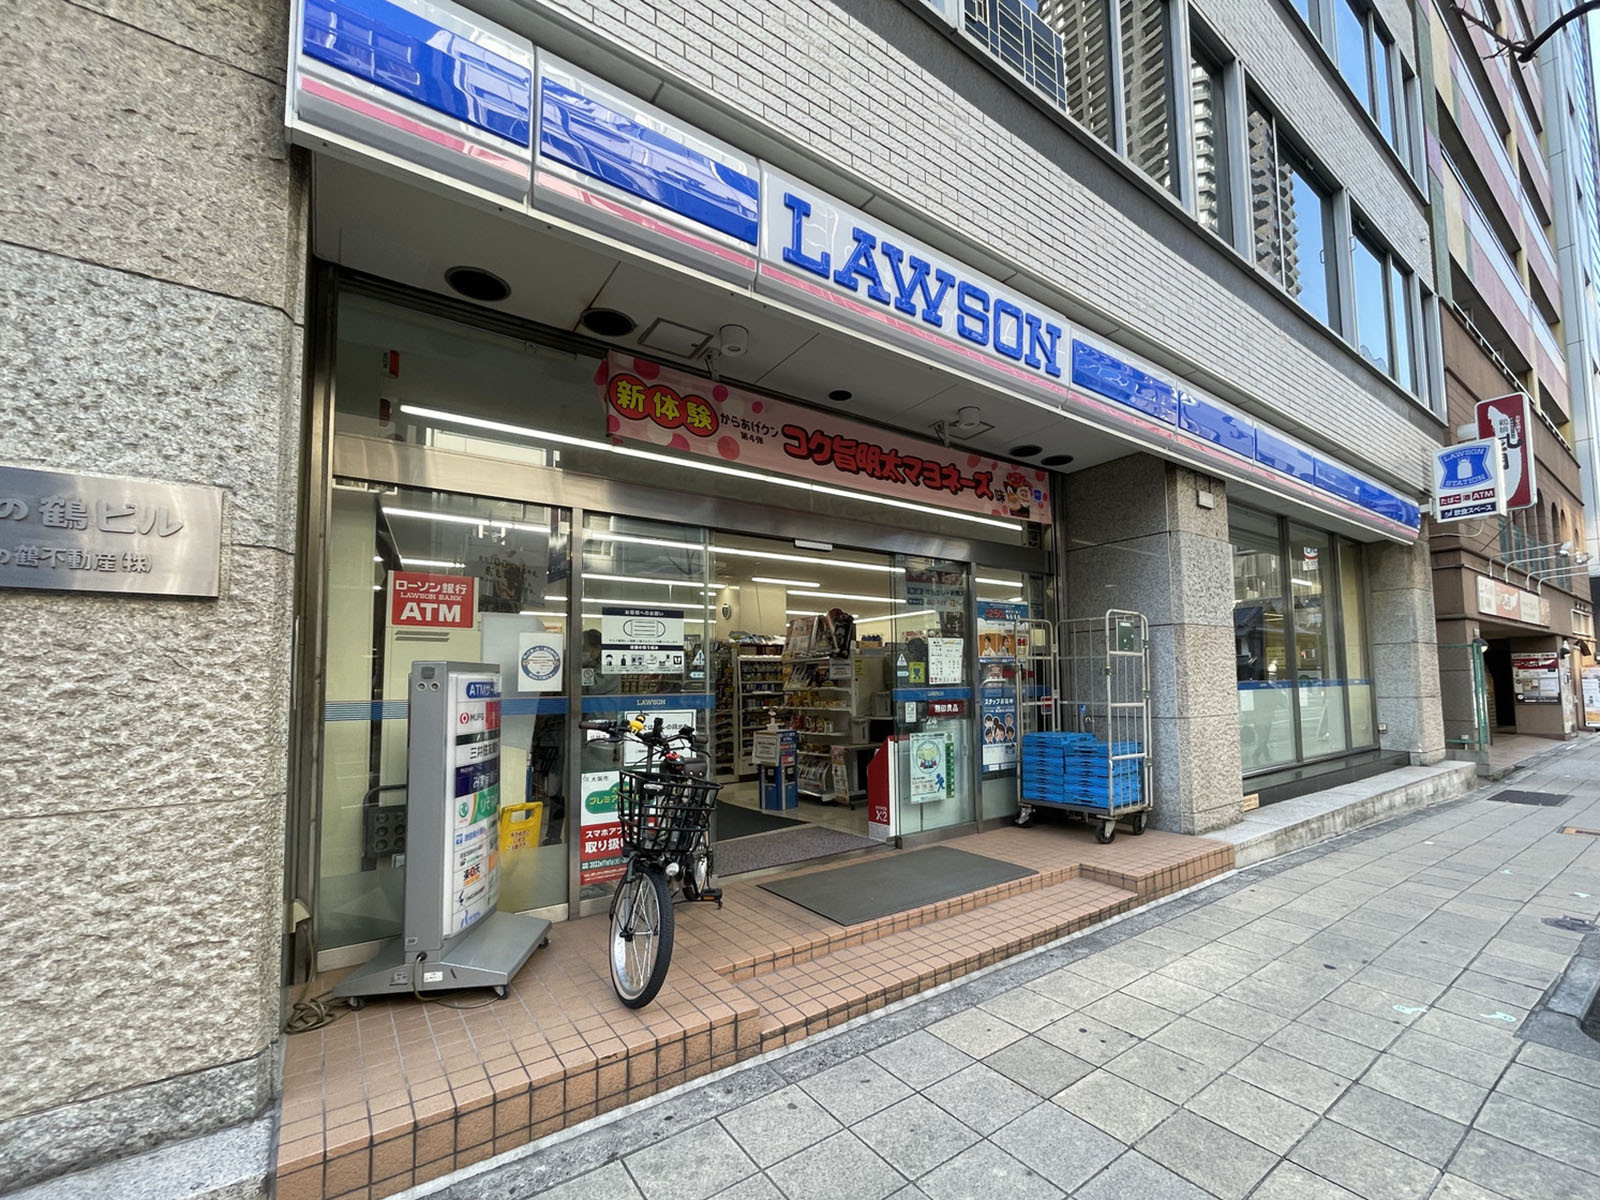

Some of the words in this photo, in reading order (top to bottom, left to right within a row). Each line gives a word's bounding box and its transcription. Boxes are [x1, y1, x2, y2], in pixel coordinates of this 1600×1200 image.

[783, 192, 1062, 378] LAWSON
[616, 379, 713, 431] 新体験
[1443, 448, 1486, 463] LAWSON
[1444, 475, 1487, 487] STATION
[1472, 490, 1494, 500] ATM
[395, 579, 469, 596] ローソン銀行
[400, 592, 437, 601] LAWSON
[438, 594, 463, 602] BANK
[400, 601, 462, 623] ATM
